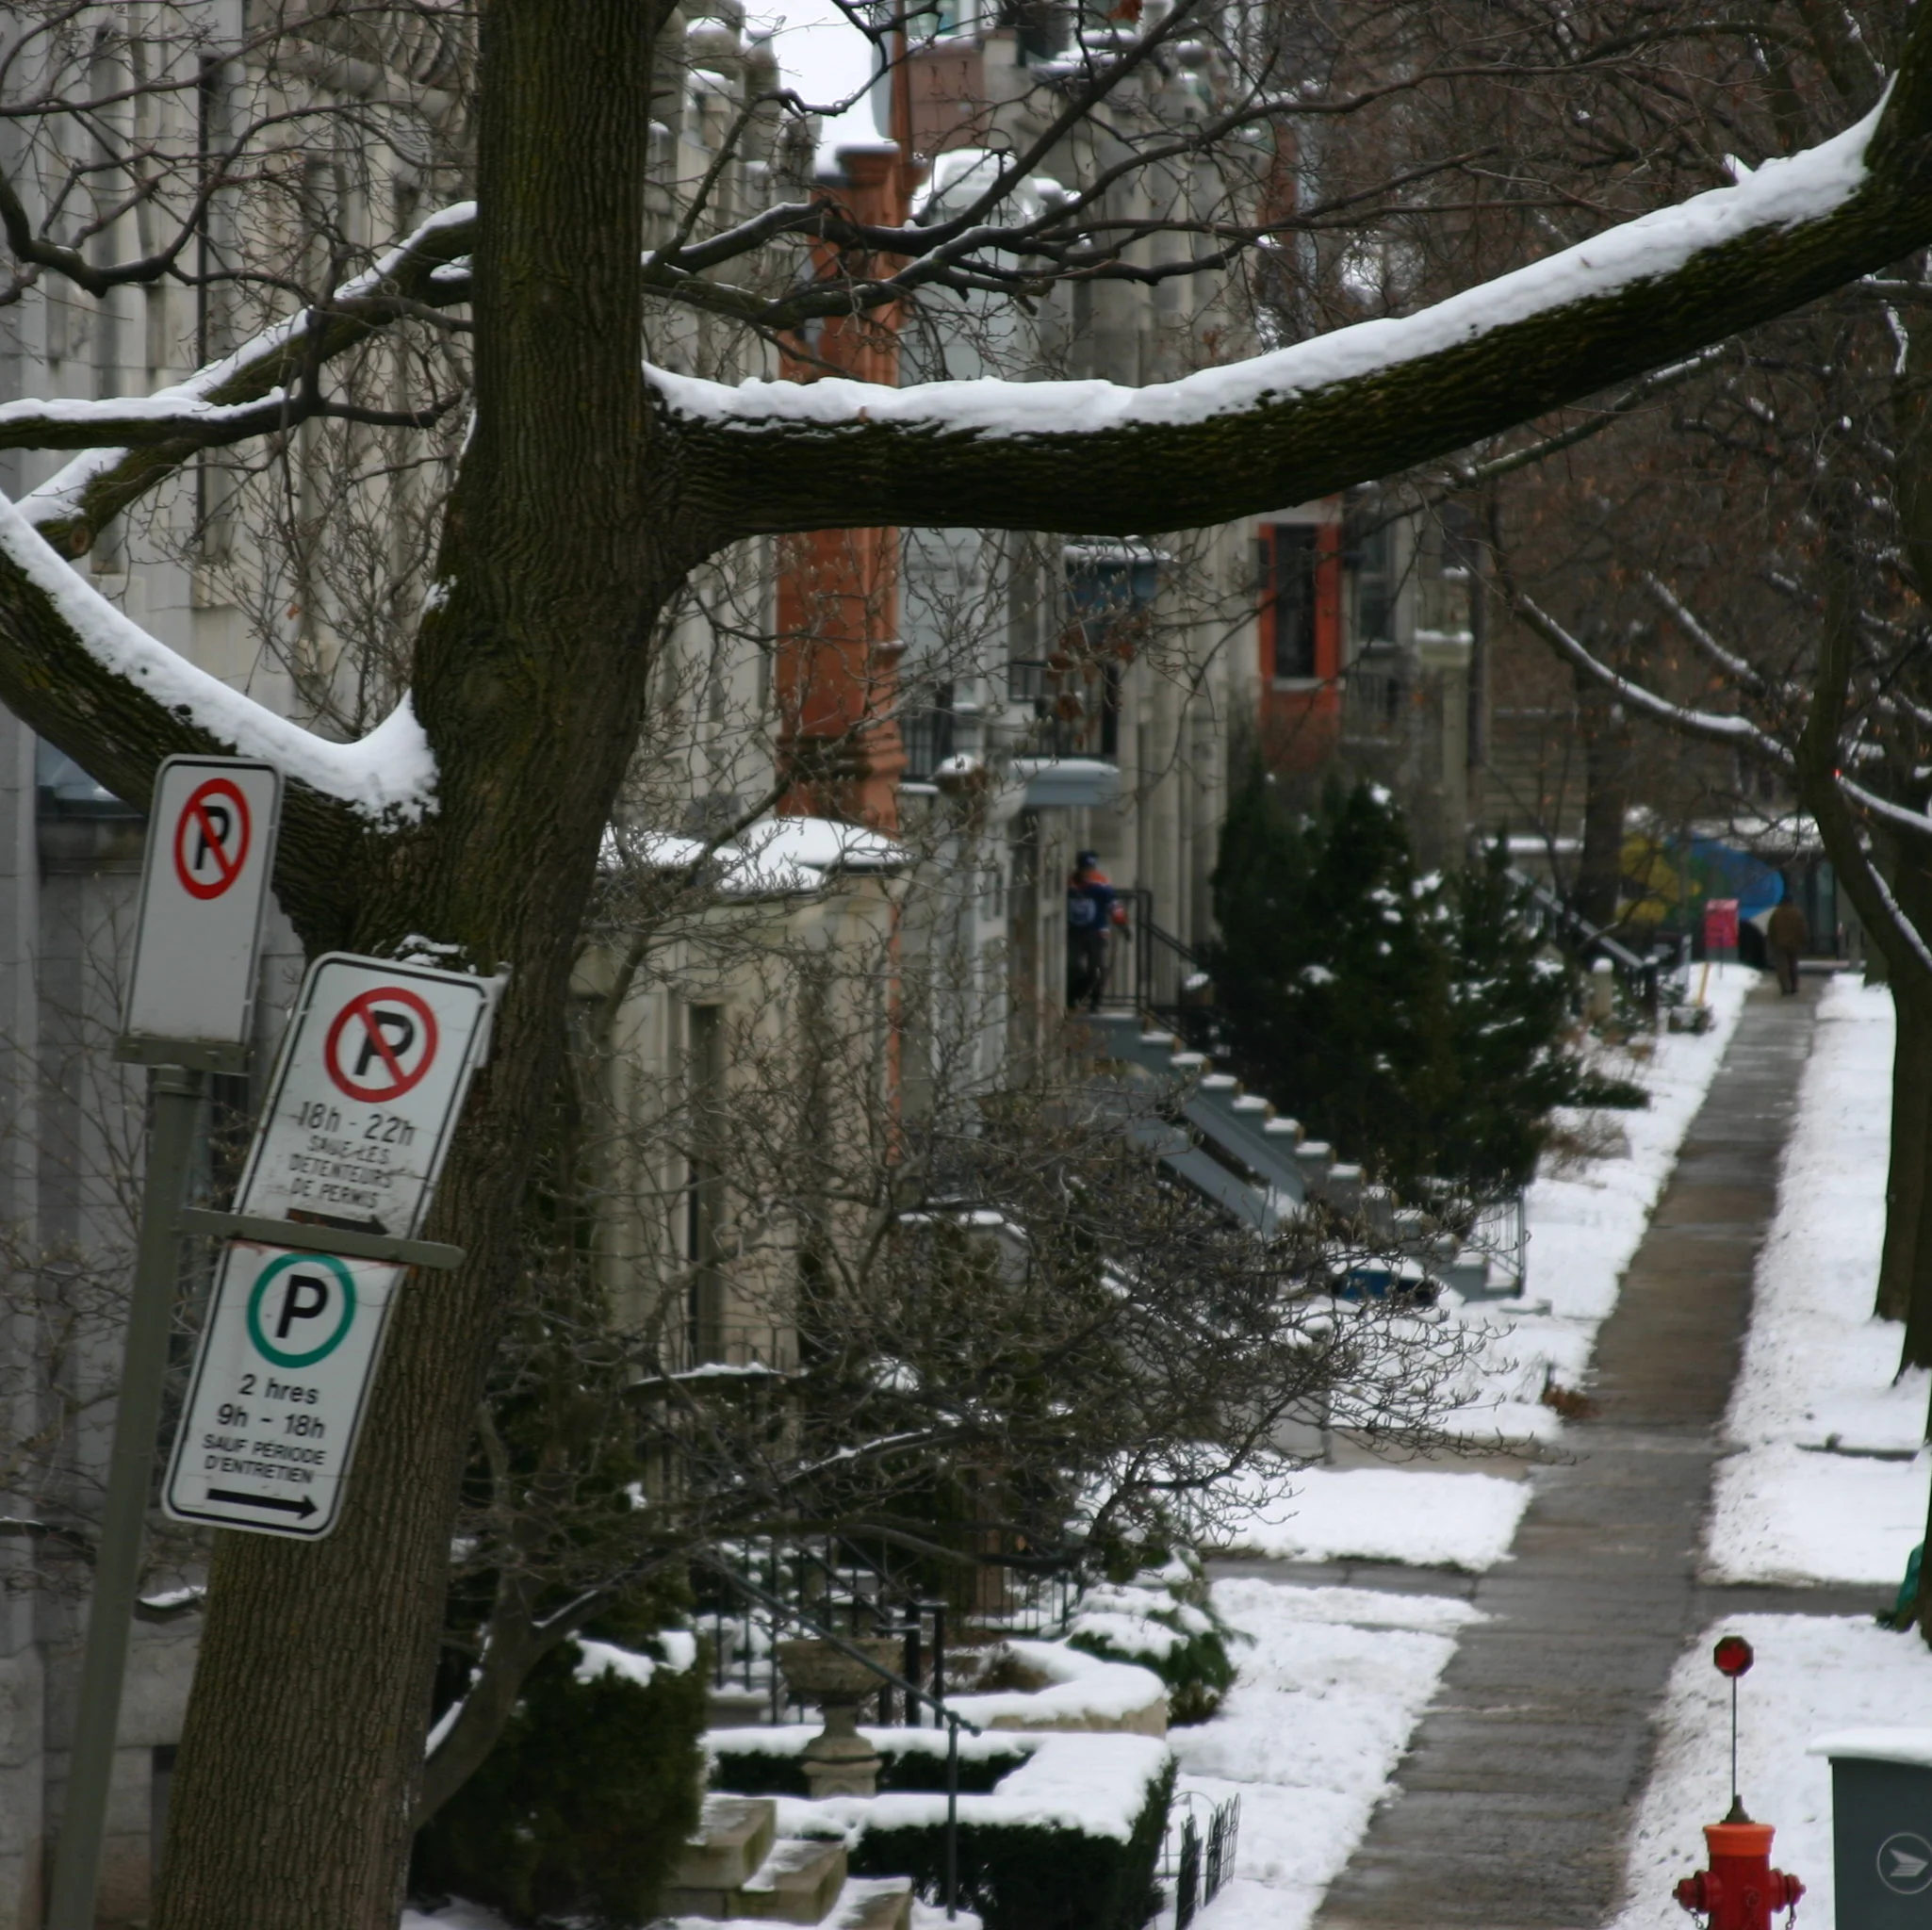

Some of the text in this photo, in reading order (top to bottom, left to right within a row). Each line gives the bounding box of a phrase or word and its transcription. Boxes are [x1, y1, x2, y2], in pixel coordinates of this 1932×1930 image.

[193, 806, 232, 871] P
[353, 1009, 416, 1076] P
[297, 1101, 341, 1133] 18h
[363, 1113, 417, 1147] 22h
[290, 1177, 315, 1198] DE
[274, 1274, 329, 1339] P
[237, 1373, 319, 1405] 2 hres
[216, 1403, 249, 1428] 9h
[285, 1414, 326, 1440] 18h
[202, 1432, 248, 1453] SAUF
[205, 1454, 315, 1484] D'ENTRETIEN
